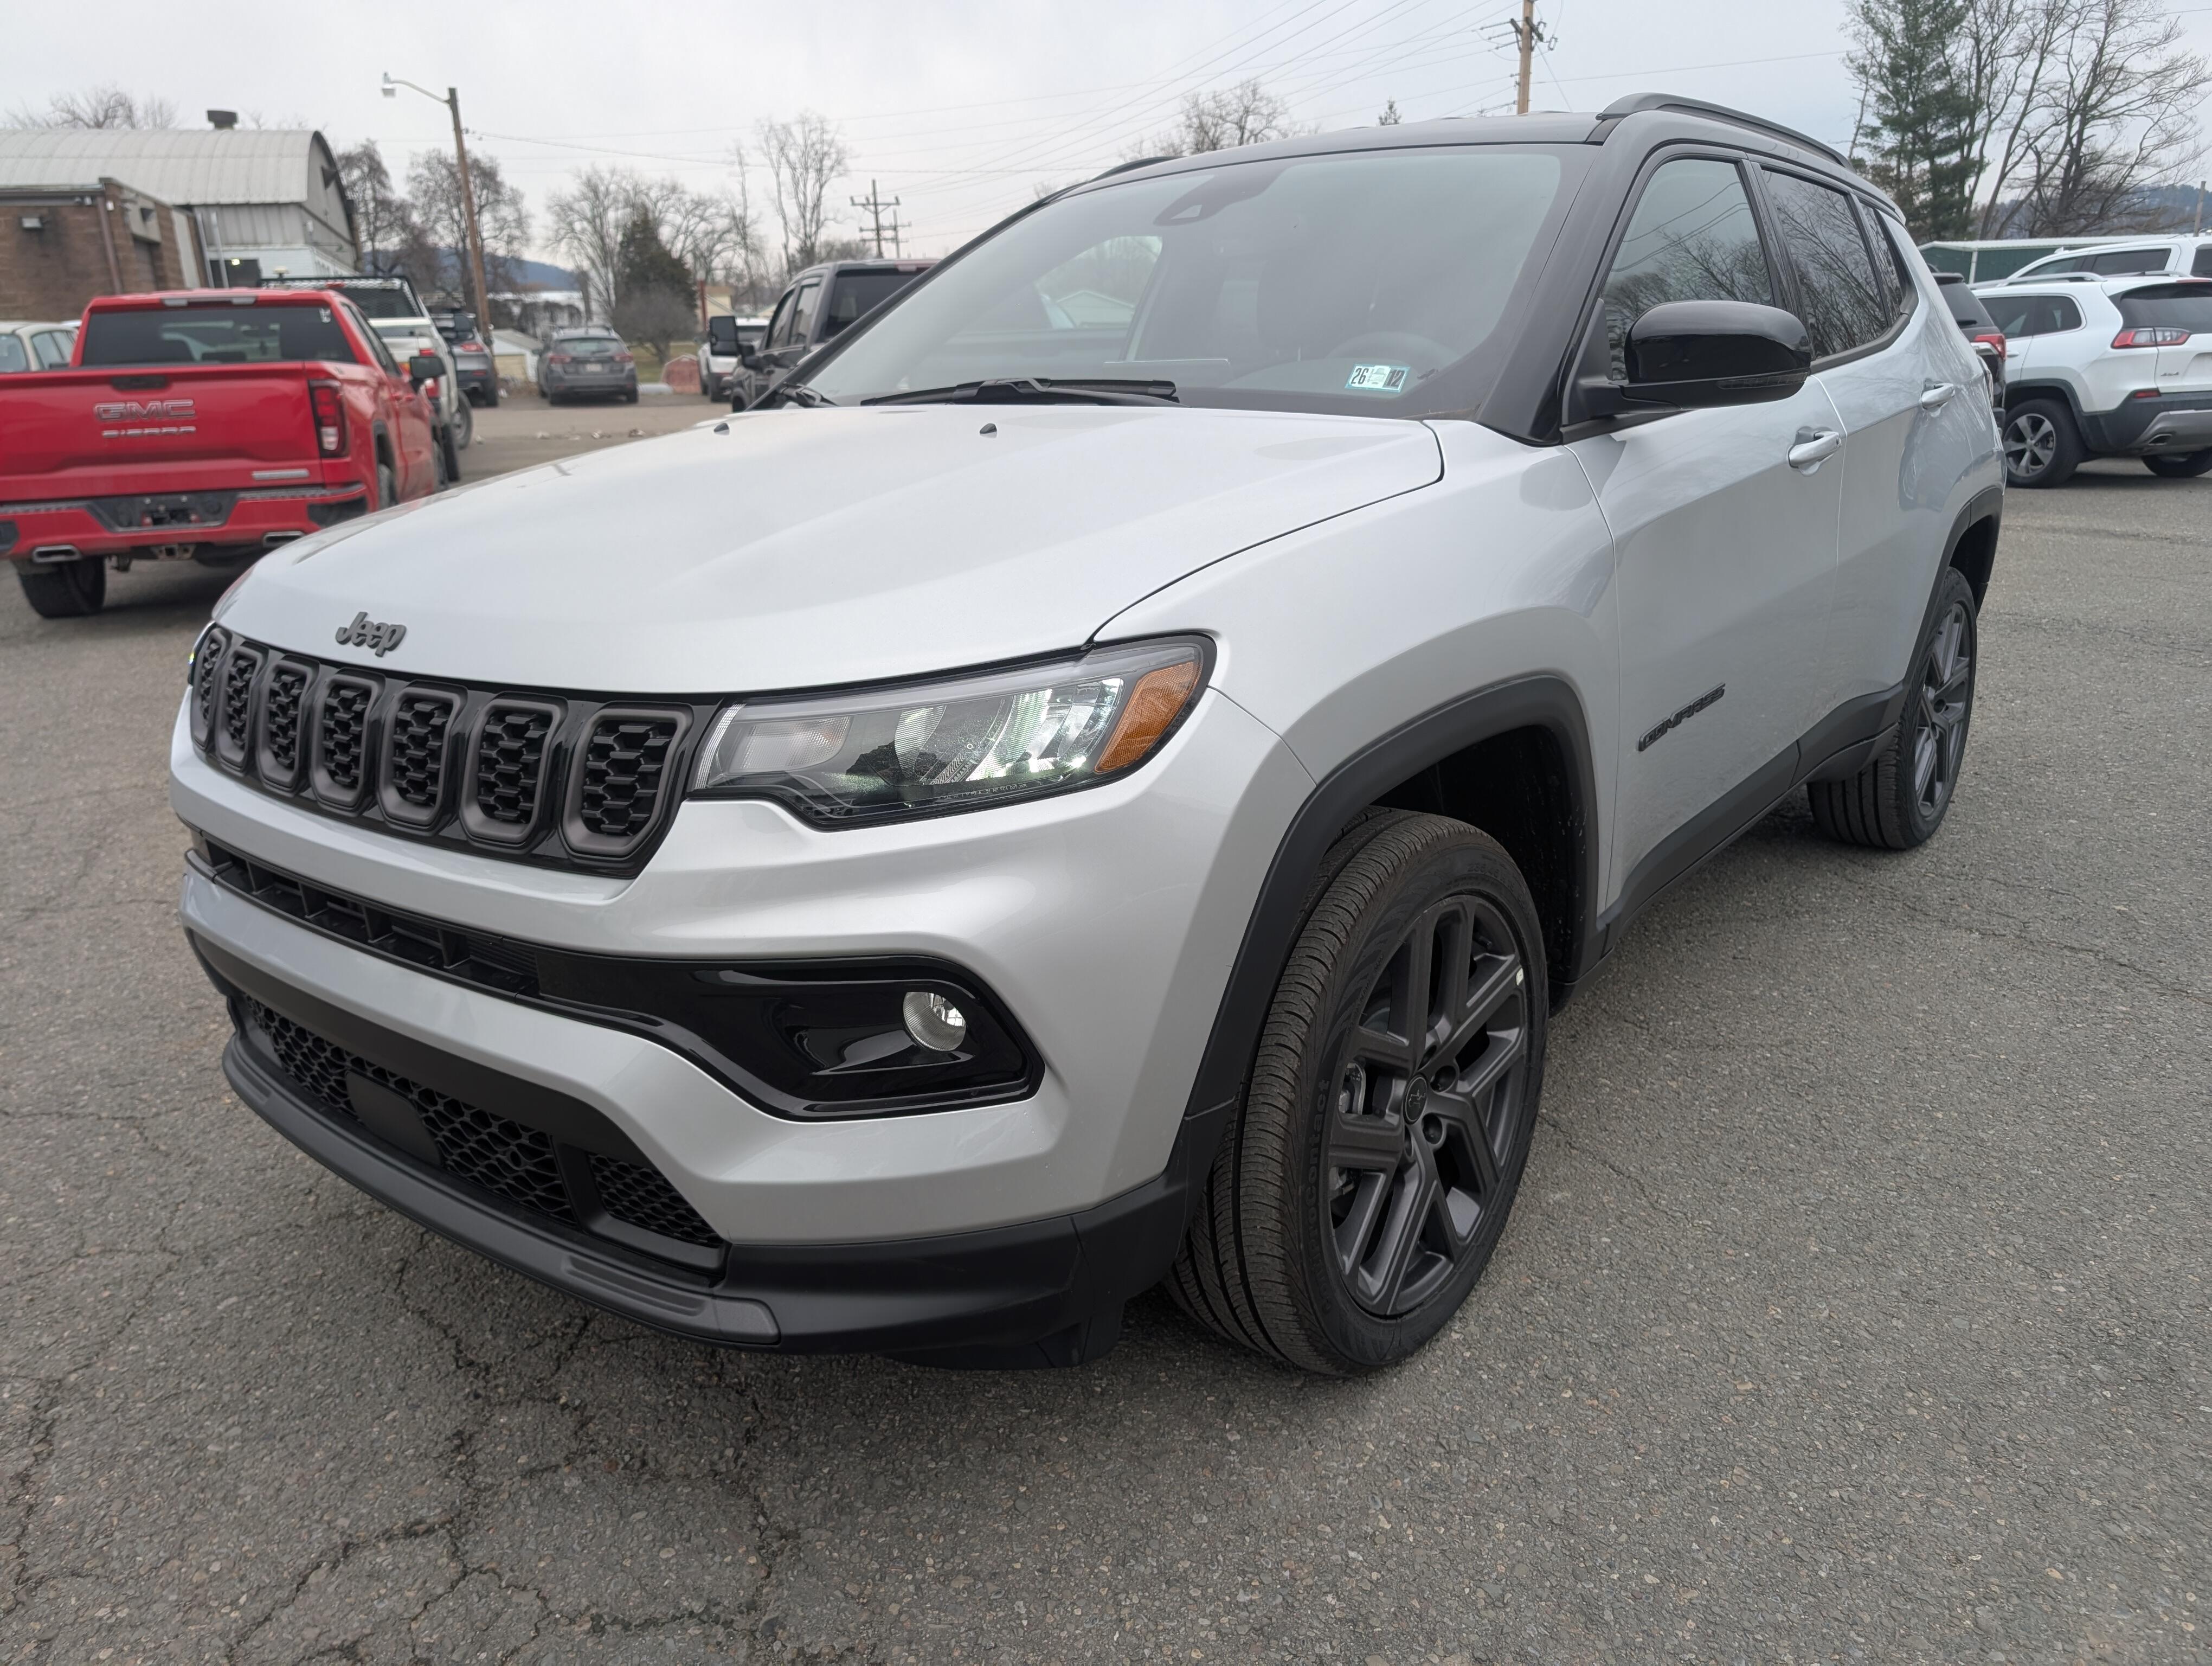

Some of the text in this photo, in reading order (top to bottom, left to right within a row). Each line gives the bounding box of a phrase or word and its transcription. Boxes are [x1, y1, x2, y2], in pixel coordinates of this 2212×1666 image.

[1351, 367, 1369, 385] 26
[1386, 369, 1405, 387] 12
[94, 399, 196, 422] GMC
[335, 611, 407, 657] Jeep
